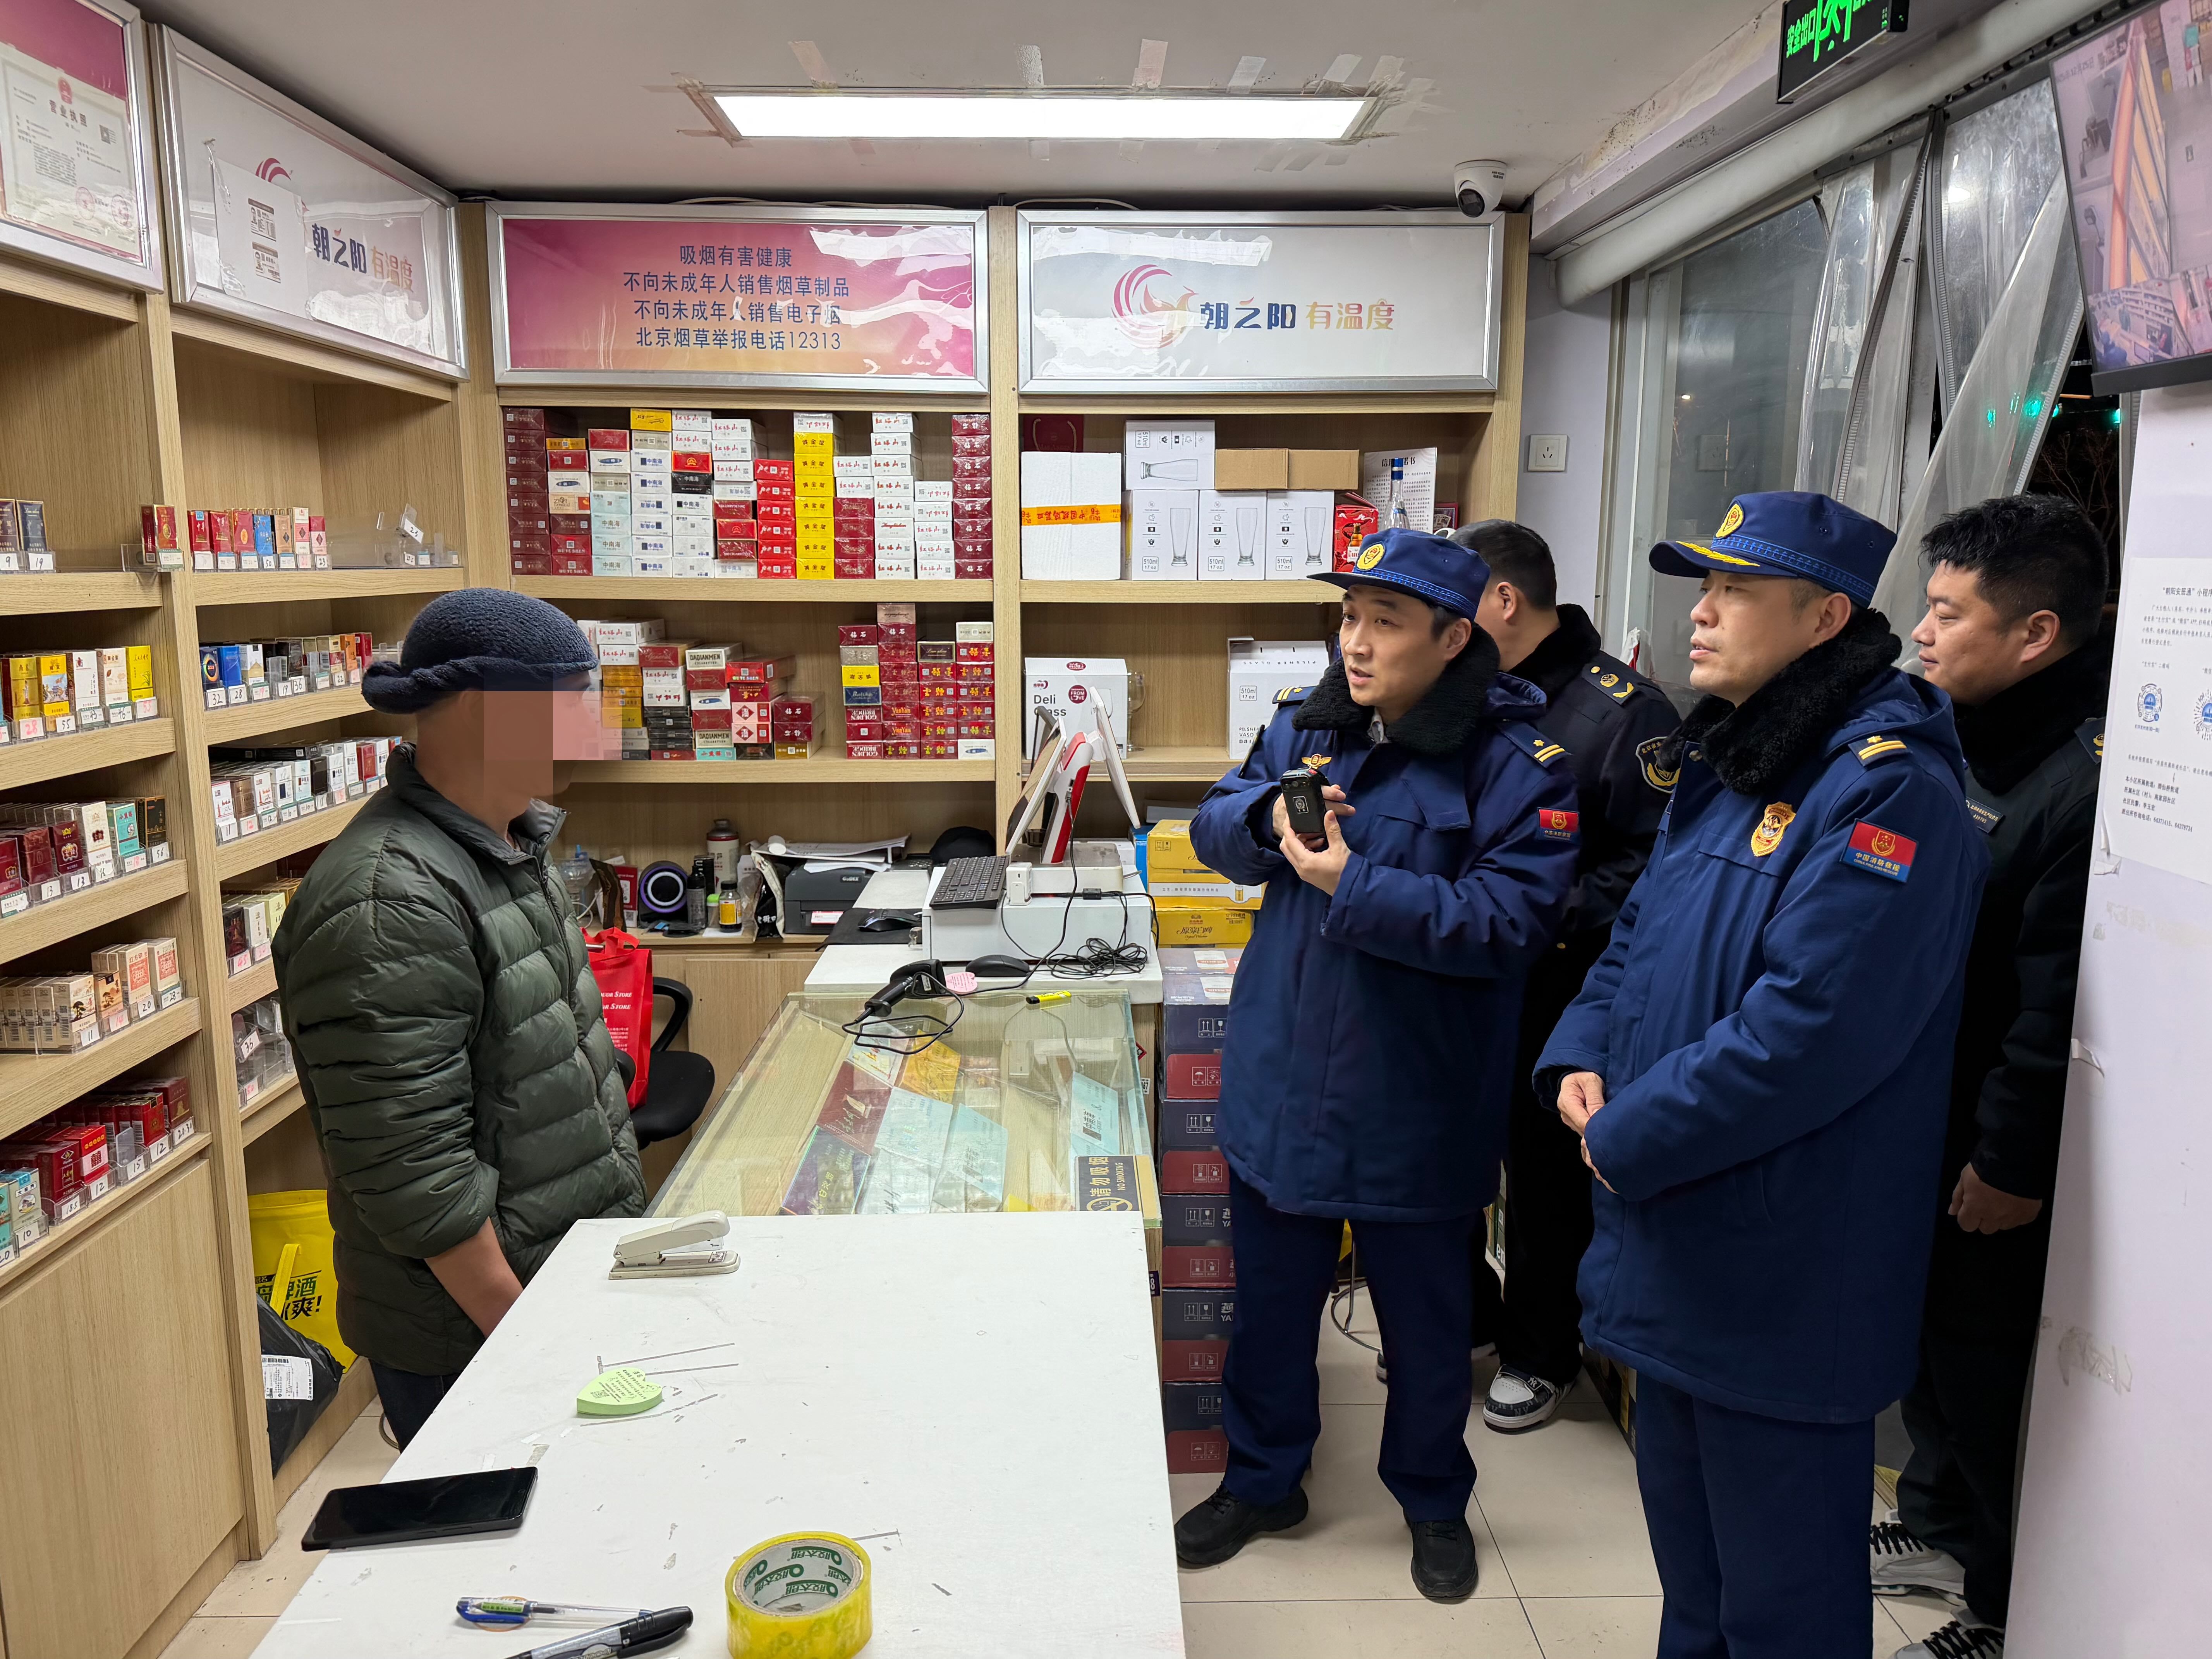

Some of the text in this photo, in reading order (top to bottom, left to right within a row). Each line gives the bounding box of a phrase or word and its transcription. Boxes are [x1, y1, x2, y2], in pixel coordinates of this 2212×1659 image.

[1786, 8, 1817, 58] 安全出口
[48, 100, 88, 127] 营业执照
[312, 223, 367, 275] 朝之阳
[371, 246, 414, 292] 有温度
[680, 244, 792, 268] 吸烟有害健康
[623, 271, 849, 298] 不向未成年人销售烟草制品
[634, 299, 841, 326] 不向未成年人销售电子烟
[1200, 297, 1395, 330] 朝之阳 有温度
[636, 328, 842, 350] 北京烟草举报电话12313
[878, 501, 902, 510] 红塔山
[878, 543, 902, 551] 红塔山
[35, 557, 43, 569] 19
[266, 560, 272, 568] 50
[318, 558, 326, 567] 23
[337, 674, 344, 683] 22
[282, 685, 288, 696] 19
[294, 680, 302, 691] 36
[212, 693, 223, 705] 32
[235, 690, 242, 700] 28
[1034, 694, 1056, 704] Deli
[143, 700, 152, 713] 55
[118, 707, 125, 720] 46
[25, 721, 38, 735] 28
[62, 718, 71, 730] 55
[226, 824, 231, 837] 11
[246, 820, 254, 830] 12
[156, 849, 163, 859] 56
[1855, 852, 1900, 872] 中国消防救援
[77, 877, 85, 887] 13
[46, 886, 53, 897] 13
[129, 952, 143, 963] 红方印
[143, 1001, 151, 1012] 20
[116, 1016, 123, 1026] 14
[88, 1030, 93, 1040] 11
[156, 1142, 166, 1155] 12
[133, 1158, 141, 1172] 15
[1088, 1157, 1111, 1197] 请勿吸烟
[1115, 1162, 1125, 1183] SMOKING
[96, 1182, 104, 1195] 12
[66, 1202, 78, 1214] 18.5
[23, 1230, 31, 1241] 10
